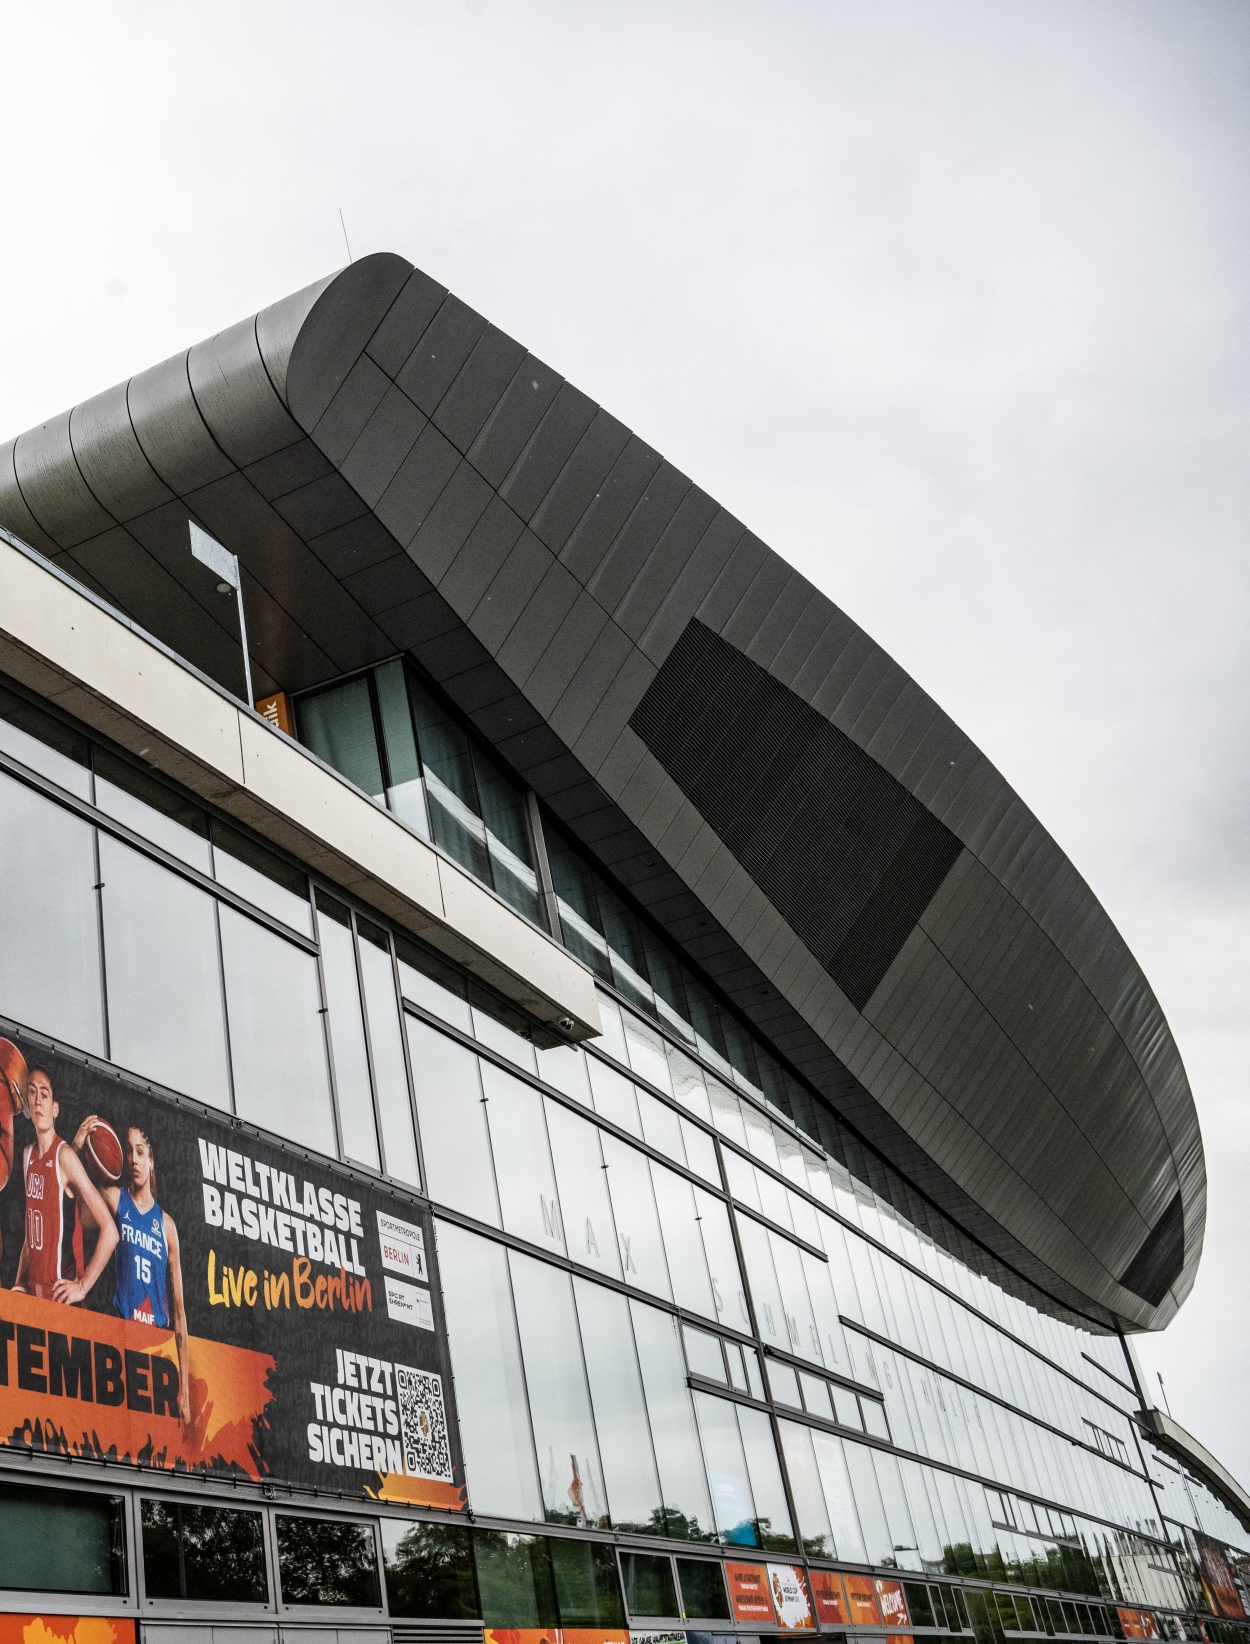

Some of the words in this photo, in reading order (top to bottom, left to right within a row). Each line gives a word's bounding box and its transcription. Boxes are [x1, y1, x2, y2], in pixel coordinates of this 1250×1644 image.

[27, 1172, 44, 1200] USA
[197, 1137, 365, 1237] WELTKLASSE
[27, 1208, 44, 1250] 10
[121, 1223, 163, 1260] FRANCE
[202, 1182, 366, 1277] BASKETBALL
[380, 1219, 421, 1241] SPORTMETROPOLE
[540, 1194, 637, 1275] MAX
[134, 1254, 152, 1284] 15
[383, 1245, 410, 1266] BERLIN
[207, 1249, 259, 1308] Live
[263, 1266, 292, 1311] in
[293, 1256, 373, 1313] Berlin
[133, 1308, 155, 1325] MAIF
[334, 1348, 394, 1391] JETZT
[310, 1382, 399, 1436] TICKETS
[307, 1422, 404, 1476] SICHERN
